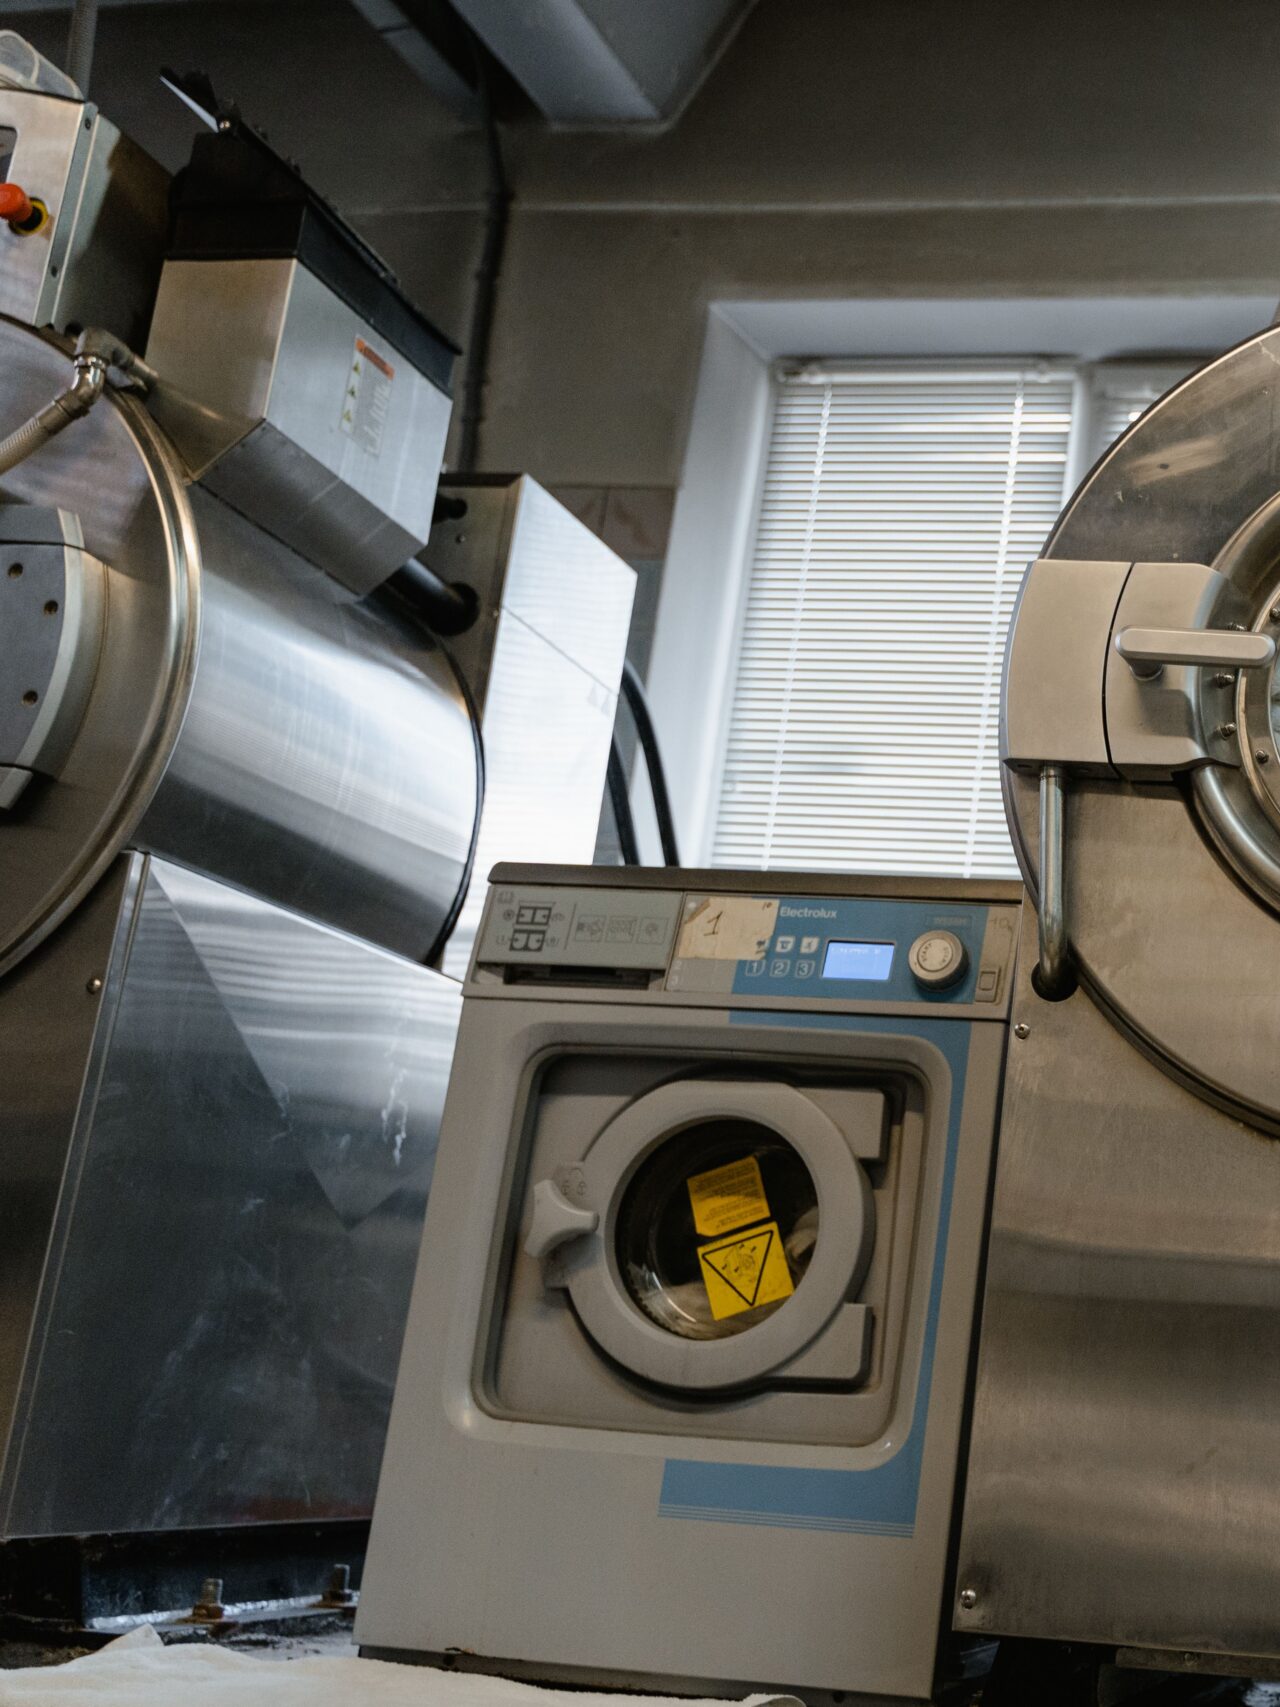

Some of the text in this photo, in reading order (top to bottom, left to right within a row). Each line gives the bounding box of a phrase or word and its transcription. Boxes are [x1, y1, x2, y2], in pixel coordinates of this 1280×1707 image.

[779, 905, 838, 919] Electrolux
[703, 911, 724, 937] 1
[751, 961, 809, 977] 1 2 3
